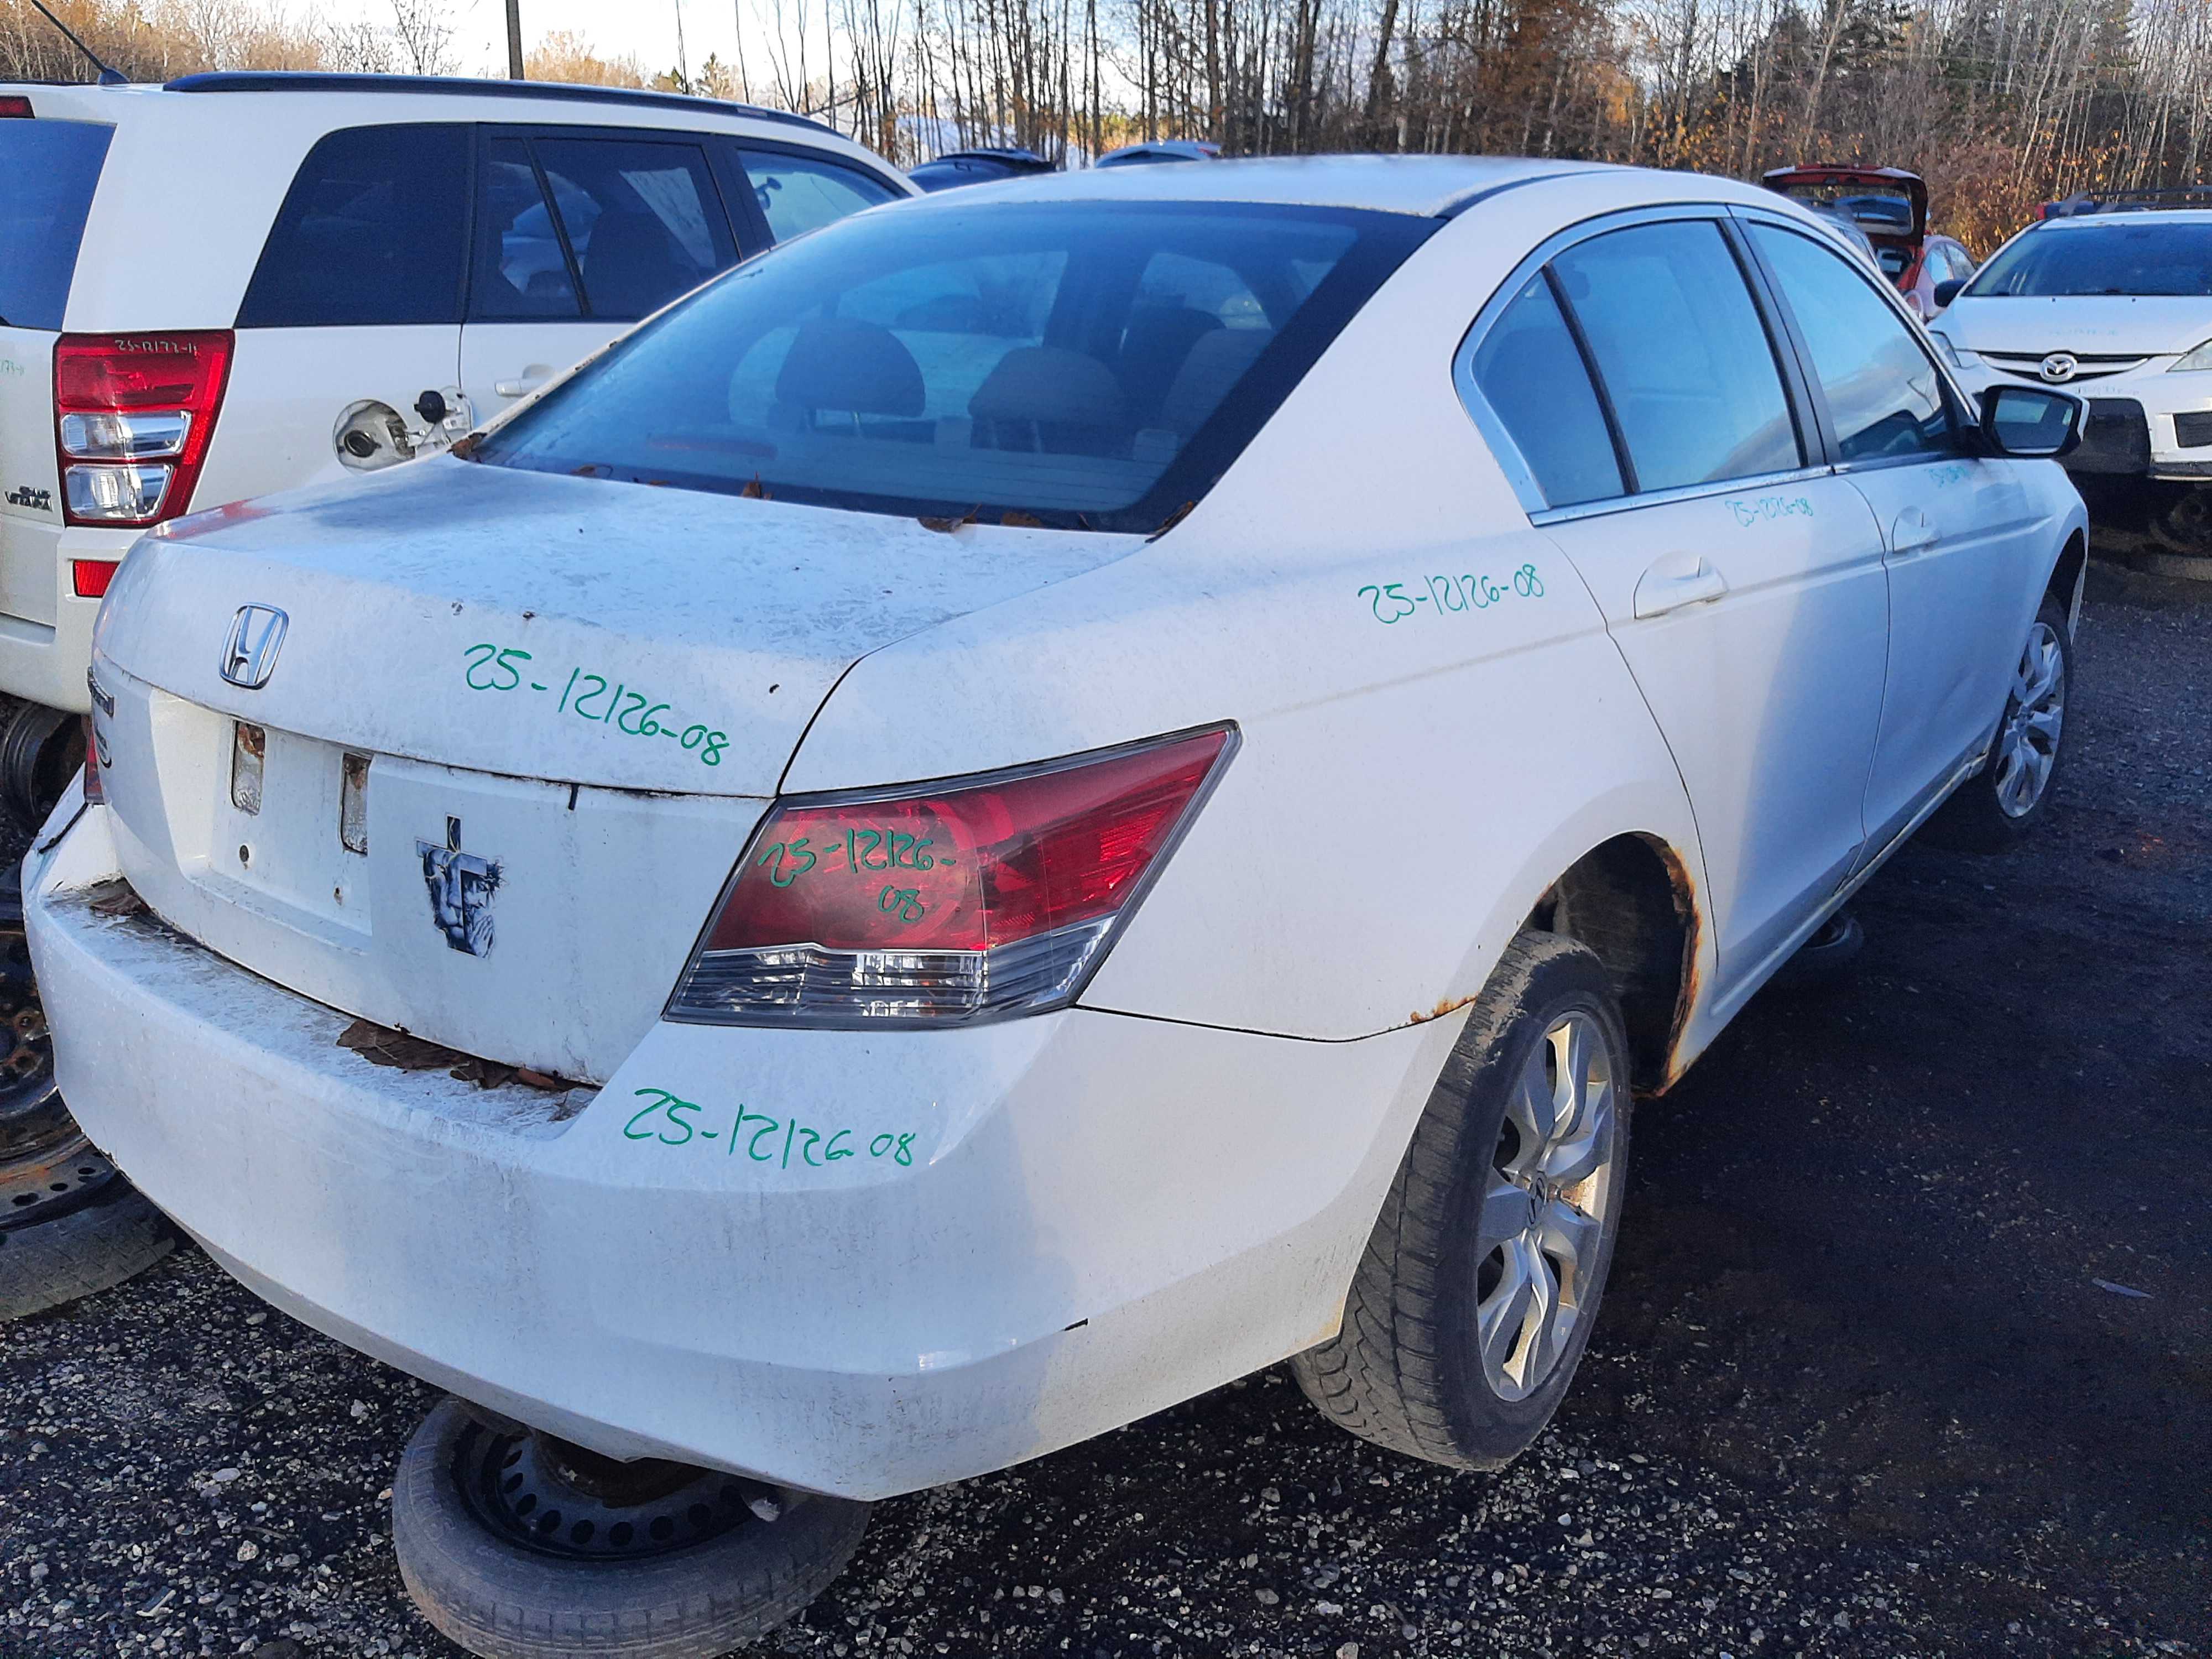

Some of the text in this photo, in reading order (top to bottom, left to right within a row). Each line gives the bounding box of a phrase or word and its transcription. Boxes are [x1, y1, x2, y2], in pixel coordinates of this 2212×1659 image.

[1358, 563, 1545, 624] 25-12126-08
[464, 643, 731, 766] 25-12126-08
[757, 828, 957, 888] 25-12126-
[878, 885, 925, 924] 08
